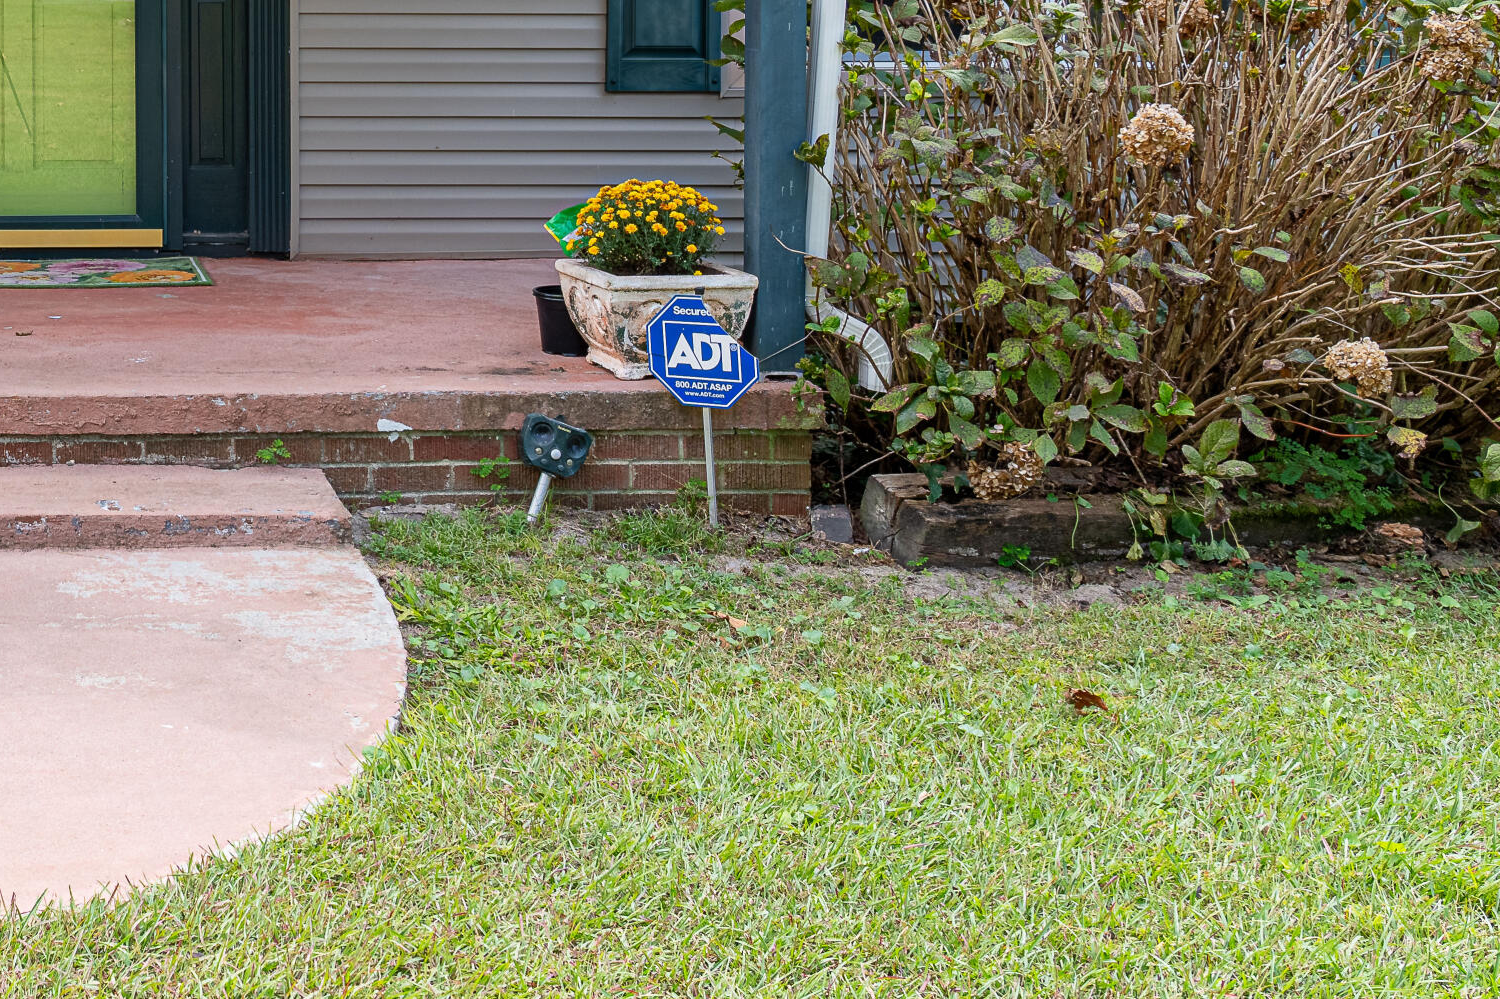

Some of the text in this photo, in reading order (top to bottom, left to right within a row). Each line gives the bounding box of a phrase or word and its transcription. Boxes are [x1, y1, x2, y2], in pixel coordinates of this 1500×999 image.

[667, 332, 737, 373] ADT
[675, 380, 733, 392] 800.ADT.ASAP
[684, 391, 725, 399] www.ADT.com
